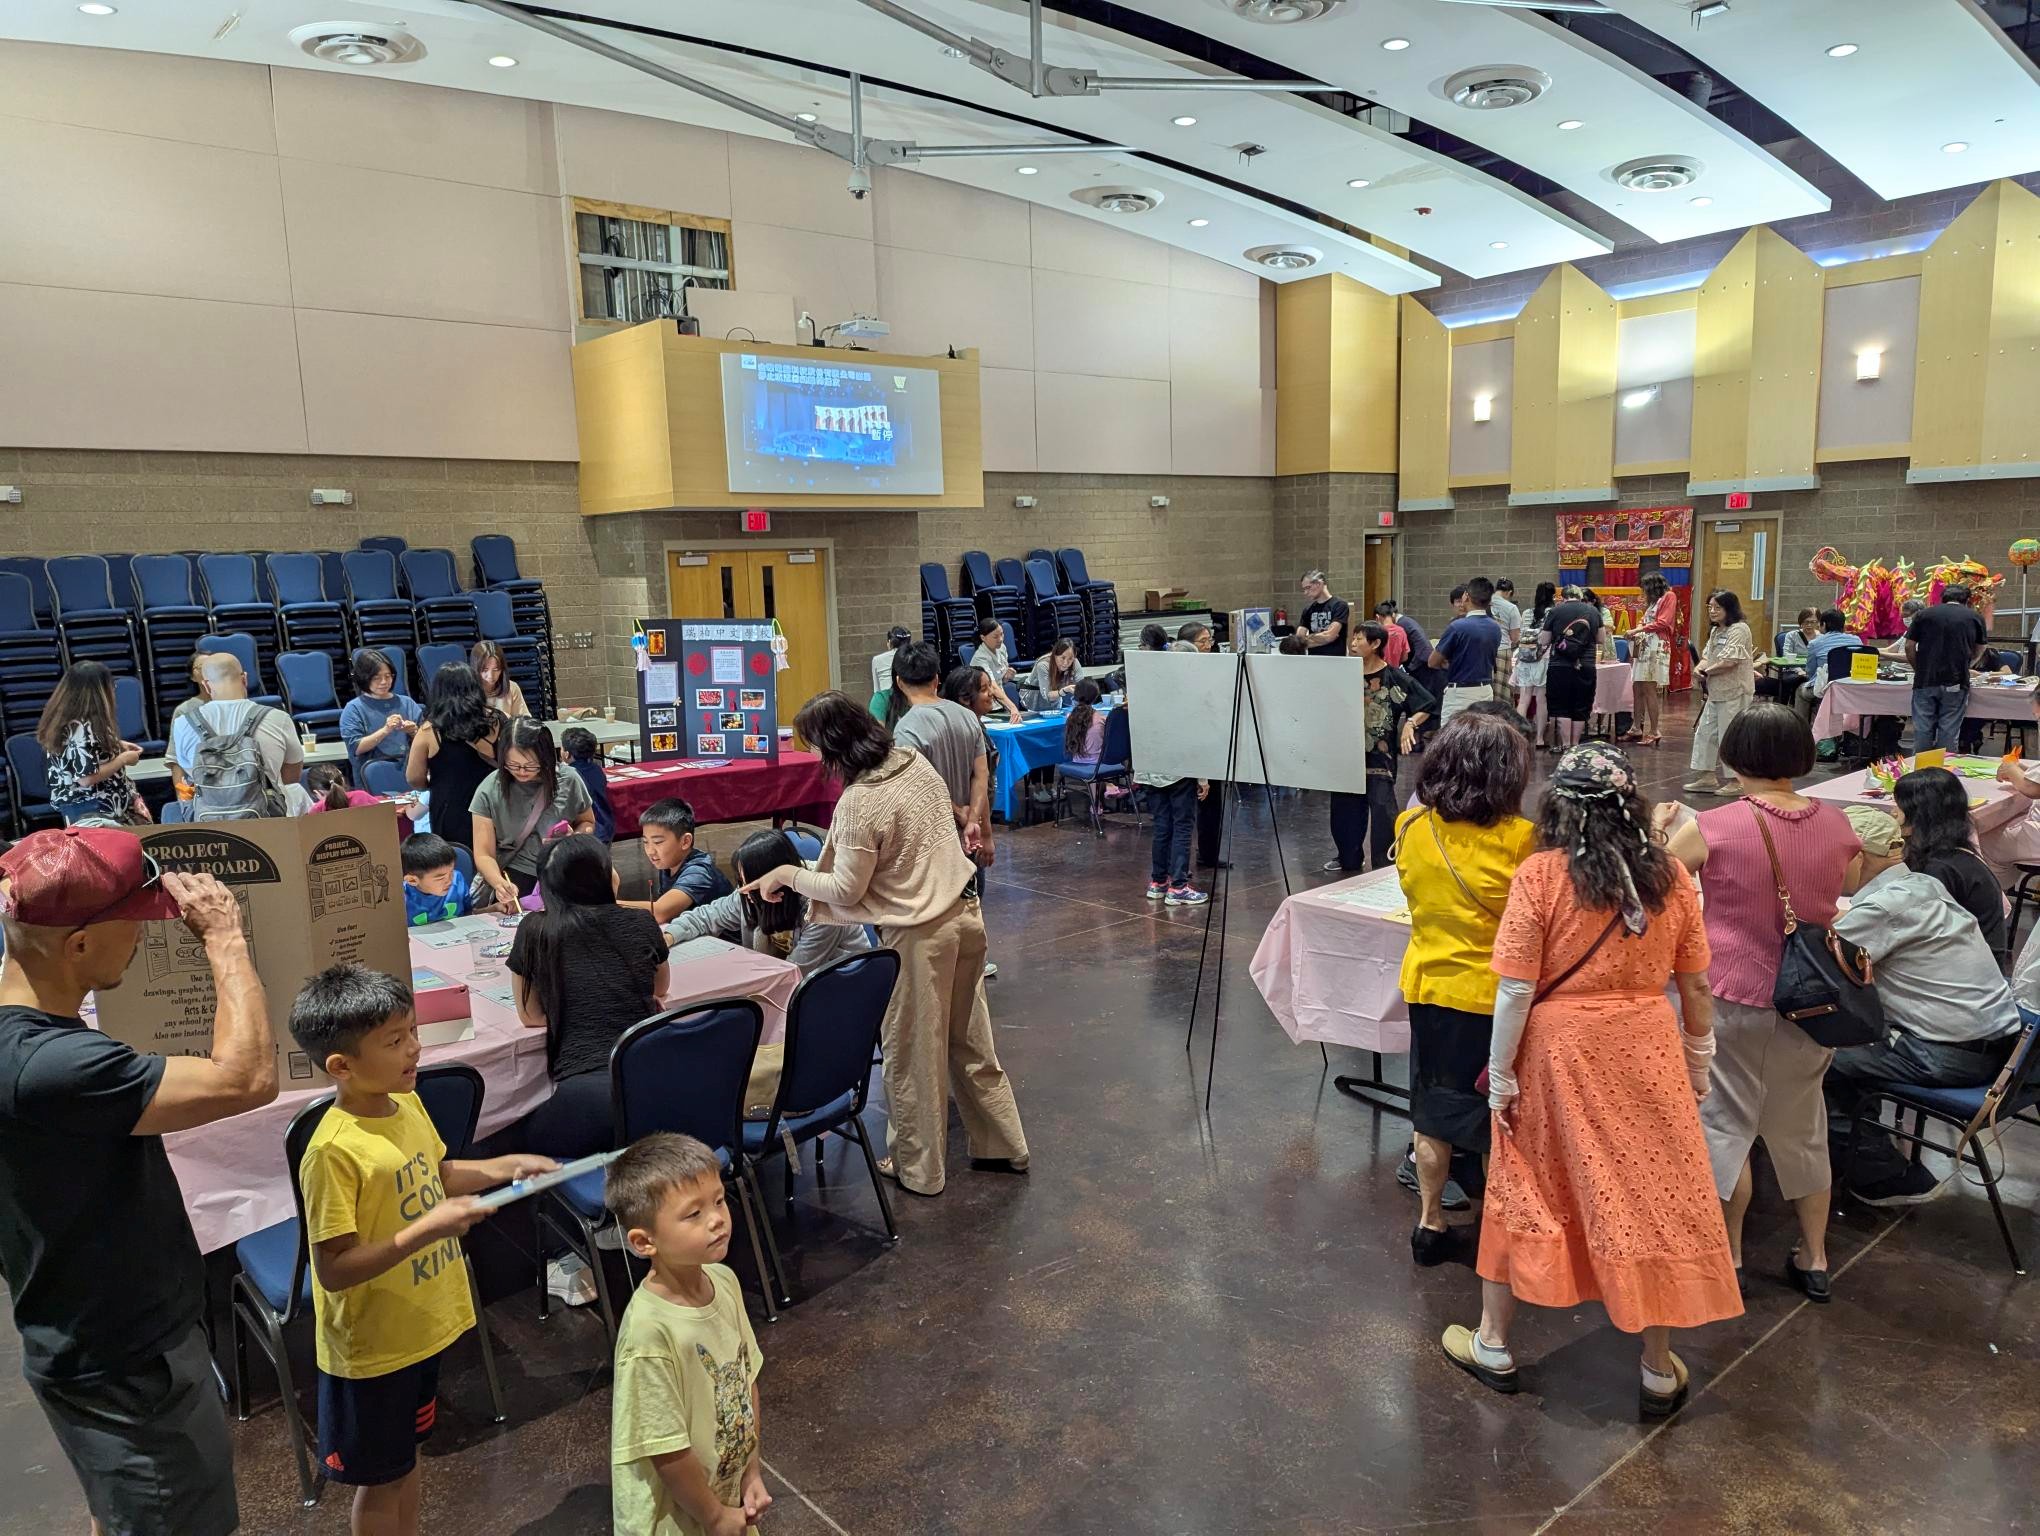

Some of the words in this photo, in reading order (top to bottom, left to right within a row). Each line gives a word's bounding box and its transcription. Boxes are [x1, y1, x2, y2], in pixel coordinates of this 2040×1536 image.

[747, 512, 767, 530] EXIT
[148, 843, 229, 860] PROJECT
[316, 850, 339, 860] DISPLAY
[340, 847, 360, 857] BOARD
[325, 841, 349, 851] PROJECT
[200, 860, 260, 875] BOARD
[184, 1006, 199, 1016] Arts
[179, 1017, 201, 1026] school
[153, 1032, 169, 1040] Also
[183, 1029, 209, 1037] instead
[395, 1151, 429, 1193] IT'S
[400, 1175, 443, 1221] COO
[411, 1237, 461, 1287] KIN
